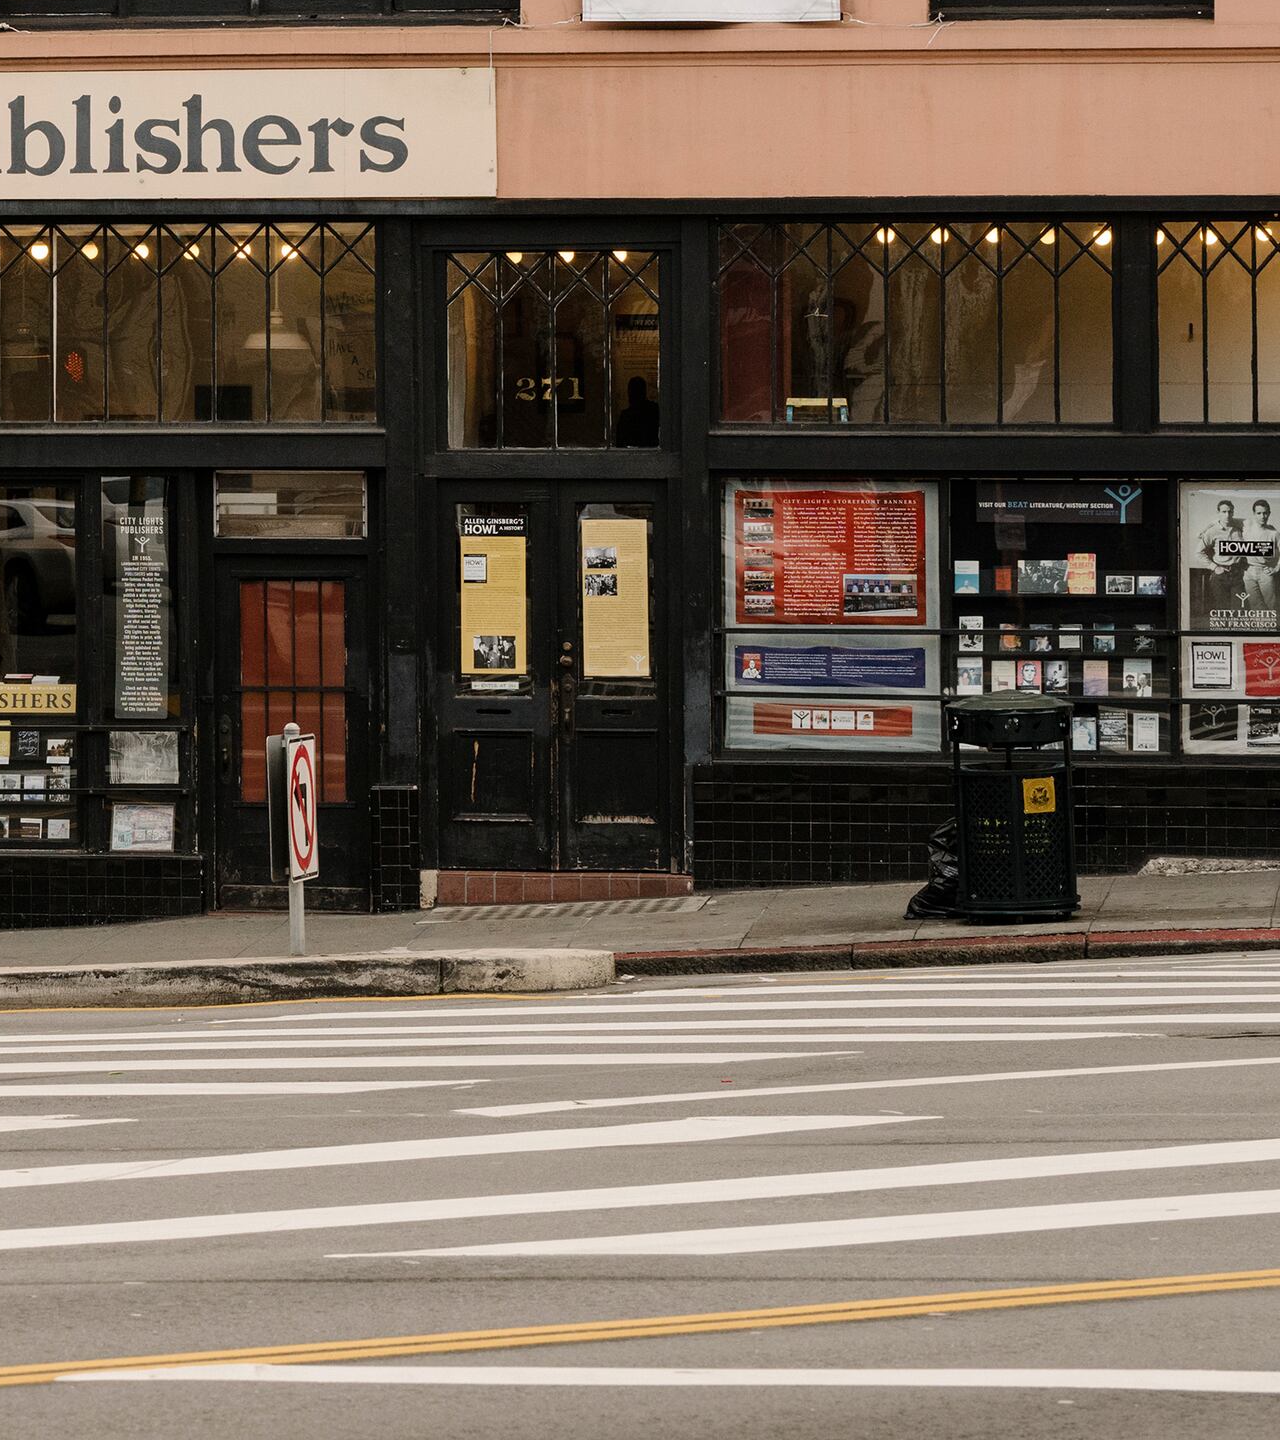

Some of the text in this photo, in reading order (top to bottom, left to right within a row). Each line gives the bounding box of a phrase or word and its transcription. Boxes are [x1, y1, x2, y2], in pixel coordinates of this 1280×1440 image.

[515, 377, 584, 401] 271
[120, 517, 164, 525] CITY LIGHTS
[120, 526, 163, 534] PUBLISHERS
[464, 525, 498, 534] HOWL
[1219, 541, 1257, 554] HOWL
[1209, 610, 1277, 618] CITY LIGHTS
[1196, 651, 1227, 660] HOWL
